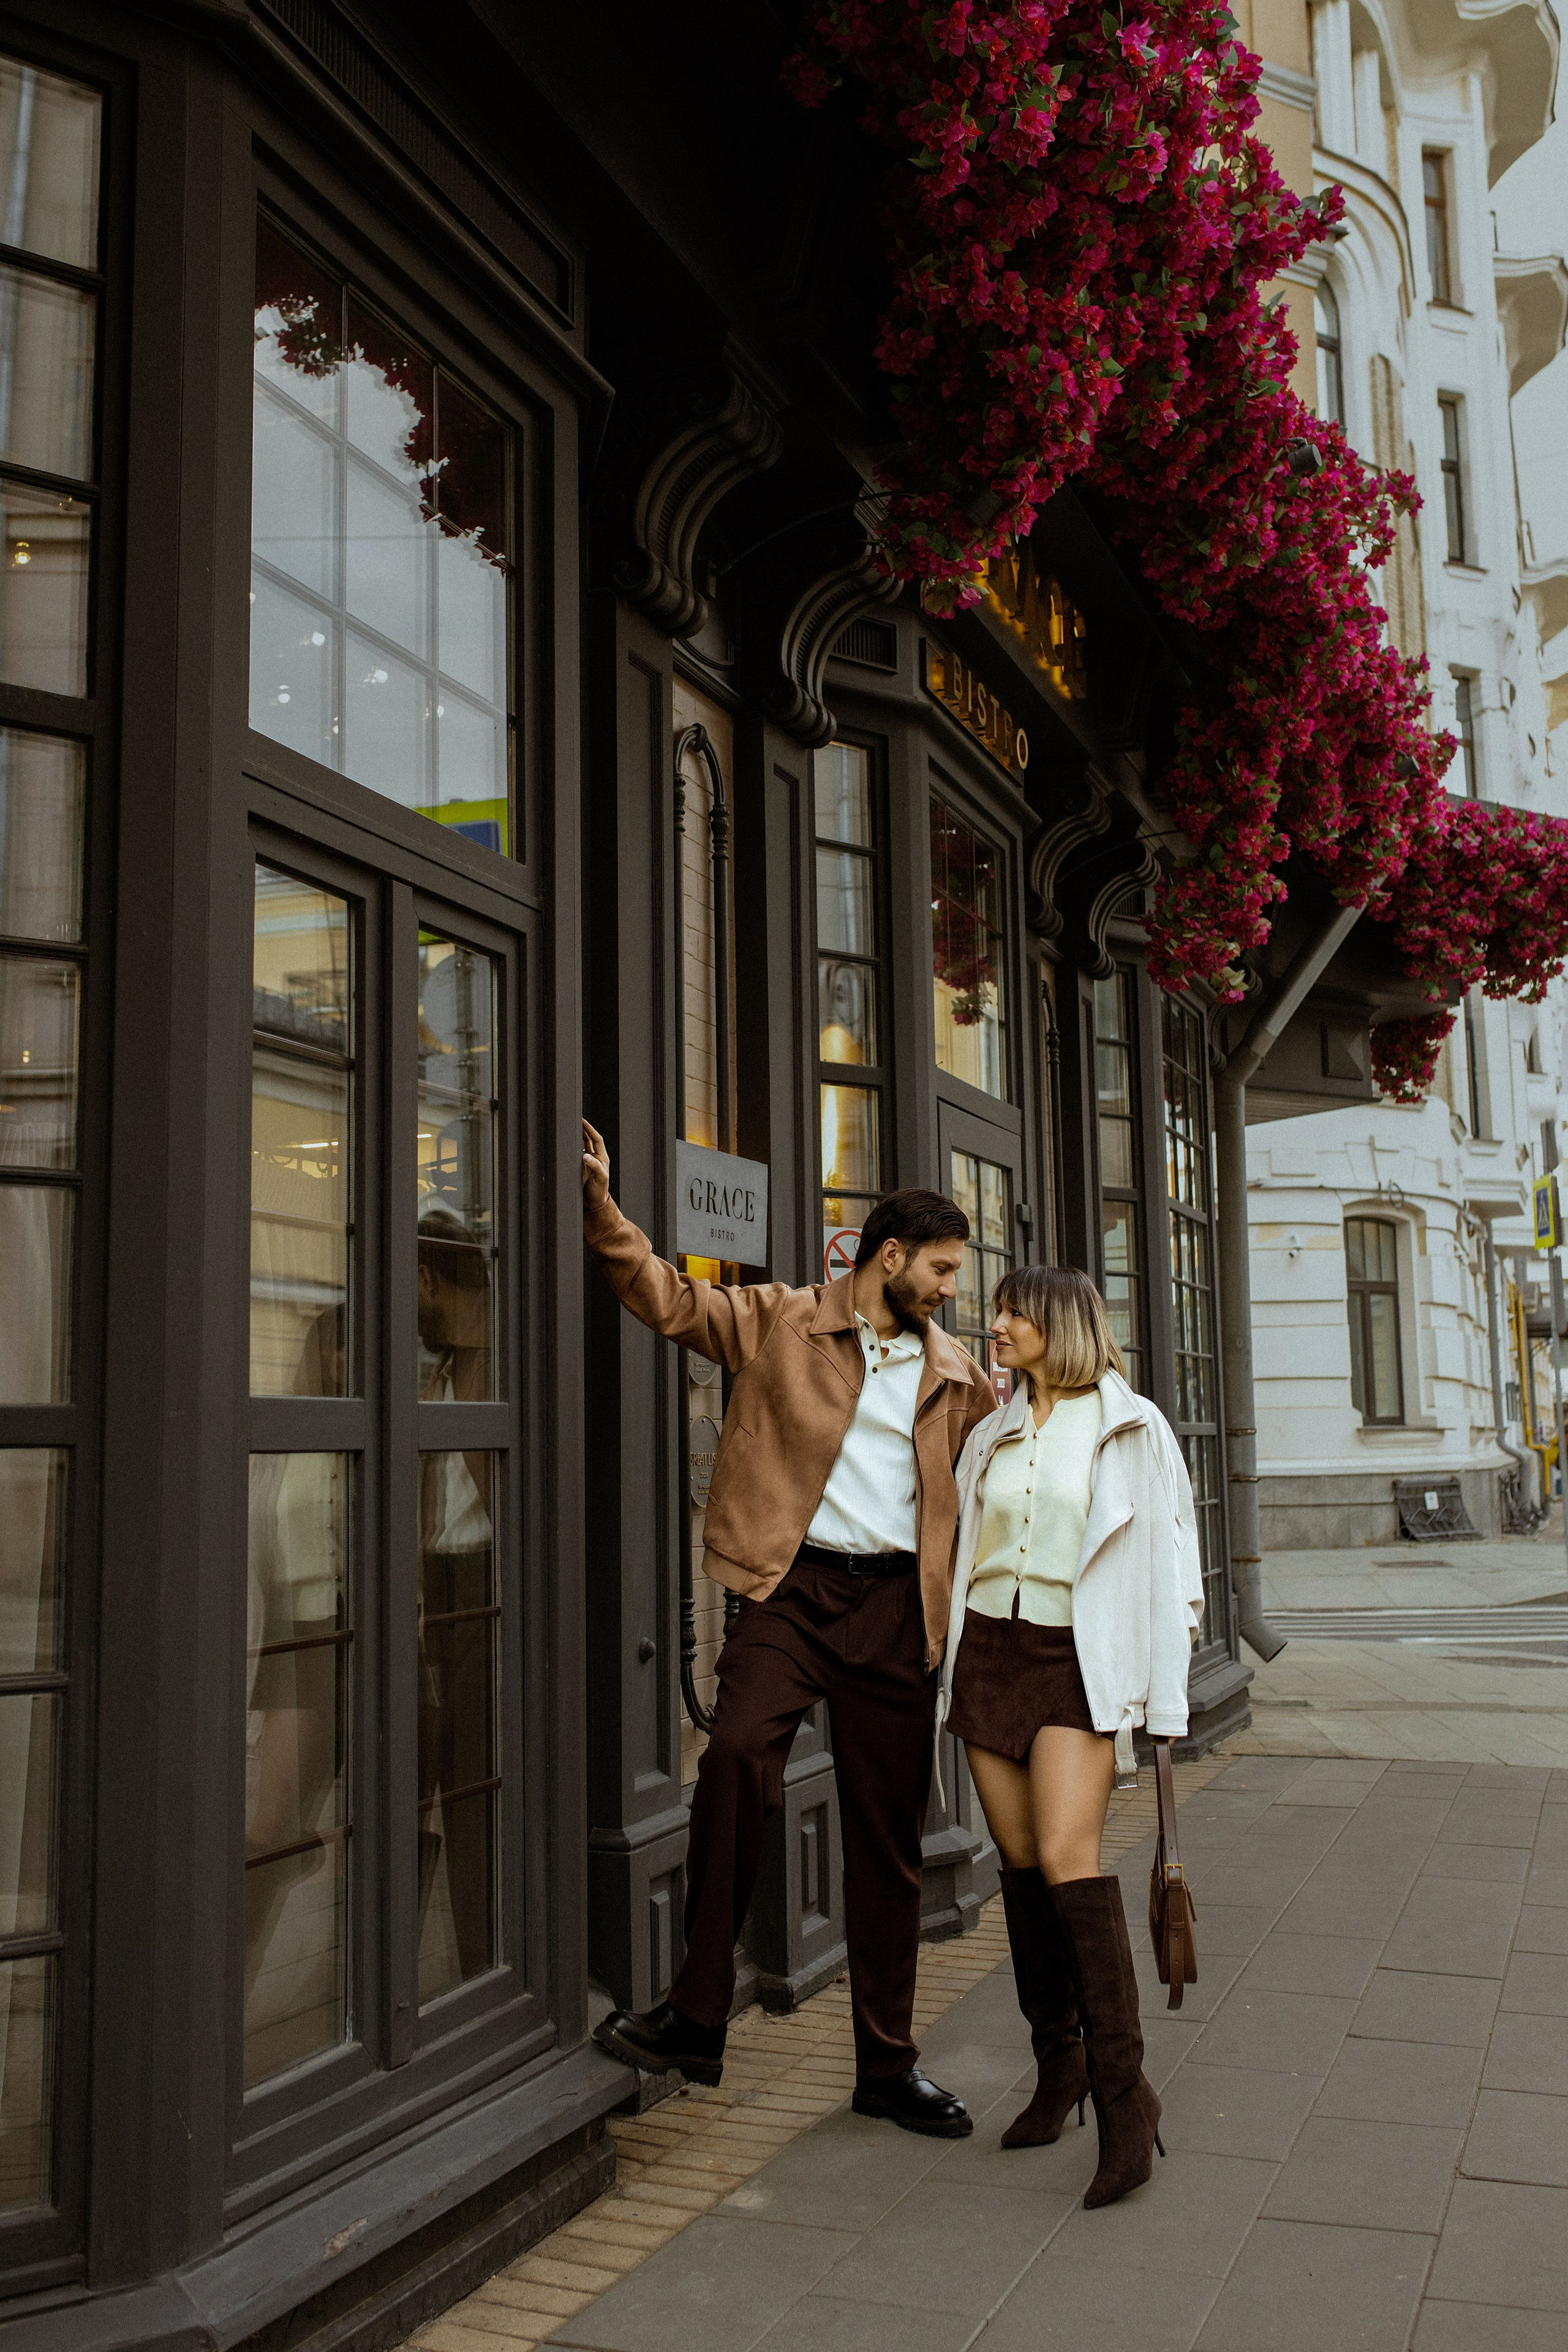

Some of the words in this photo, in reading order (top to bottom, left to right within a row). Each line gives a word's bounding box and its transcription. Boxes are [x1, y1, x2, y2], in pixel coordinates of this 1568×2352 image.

[951, 652, 1028, 769] BISTRO
[690, 1178, 755, 1222] GRACE
[710, 1228, 734, 1242] BISTRO
